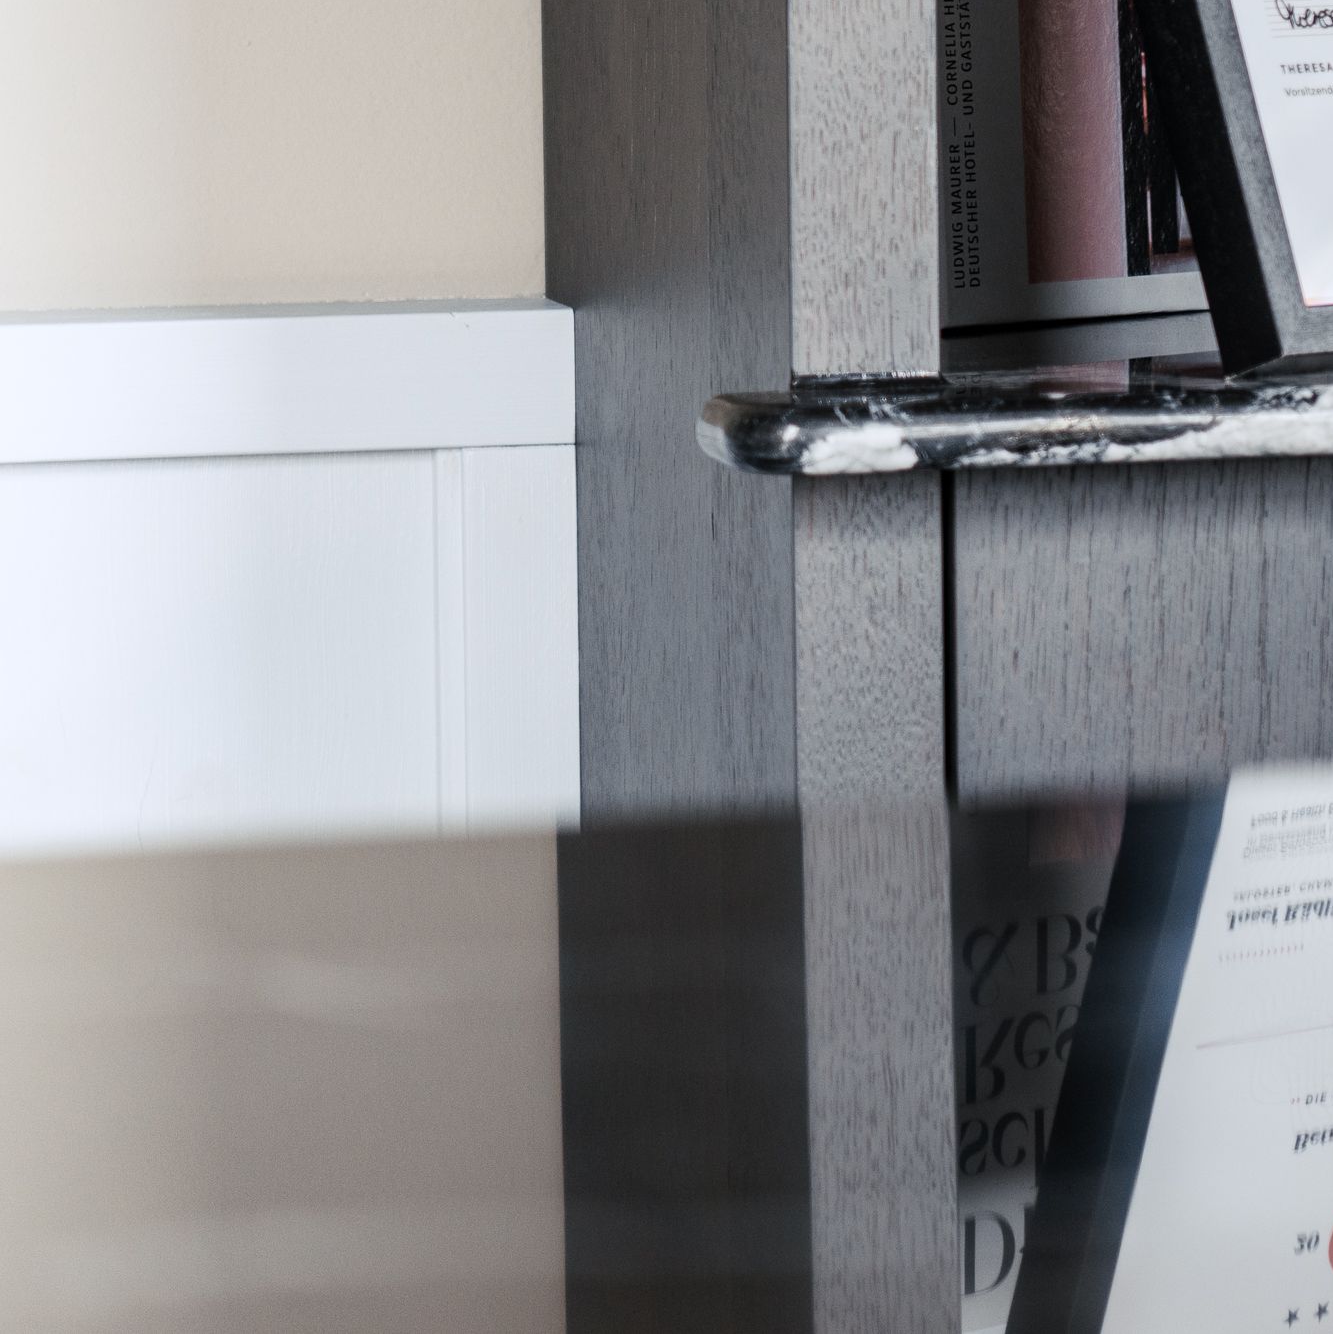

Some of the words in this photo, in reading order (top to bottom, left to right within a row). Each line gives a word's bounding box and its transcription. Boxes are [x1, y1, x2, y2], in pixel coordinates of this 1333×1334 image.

[944, 24, 958, 106] CORNELIA
[961, 80, 974, 116] UND
[1281, 61, 1333, 74] THERESA
[948, 144, 963, 214] MAURER
[962, 122, 976, 182] HOTEL-
[951, 222, 966, 288] LUDWIG
[964, 189, 981, 287] DEUTSCHER
